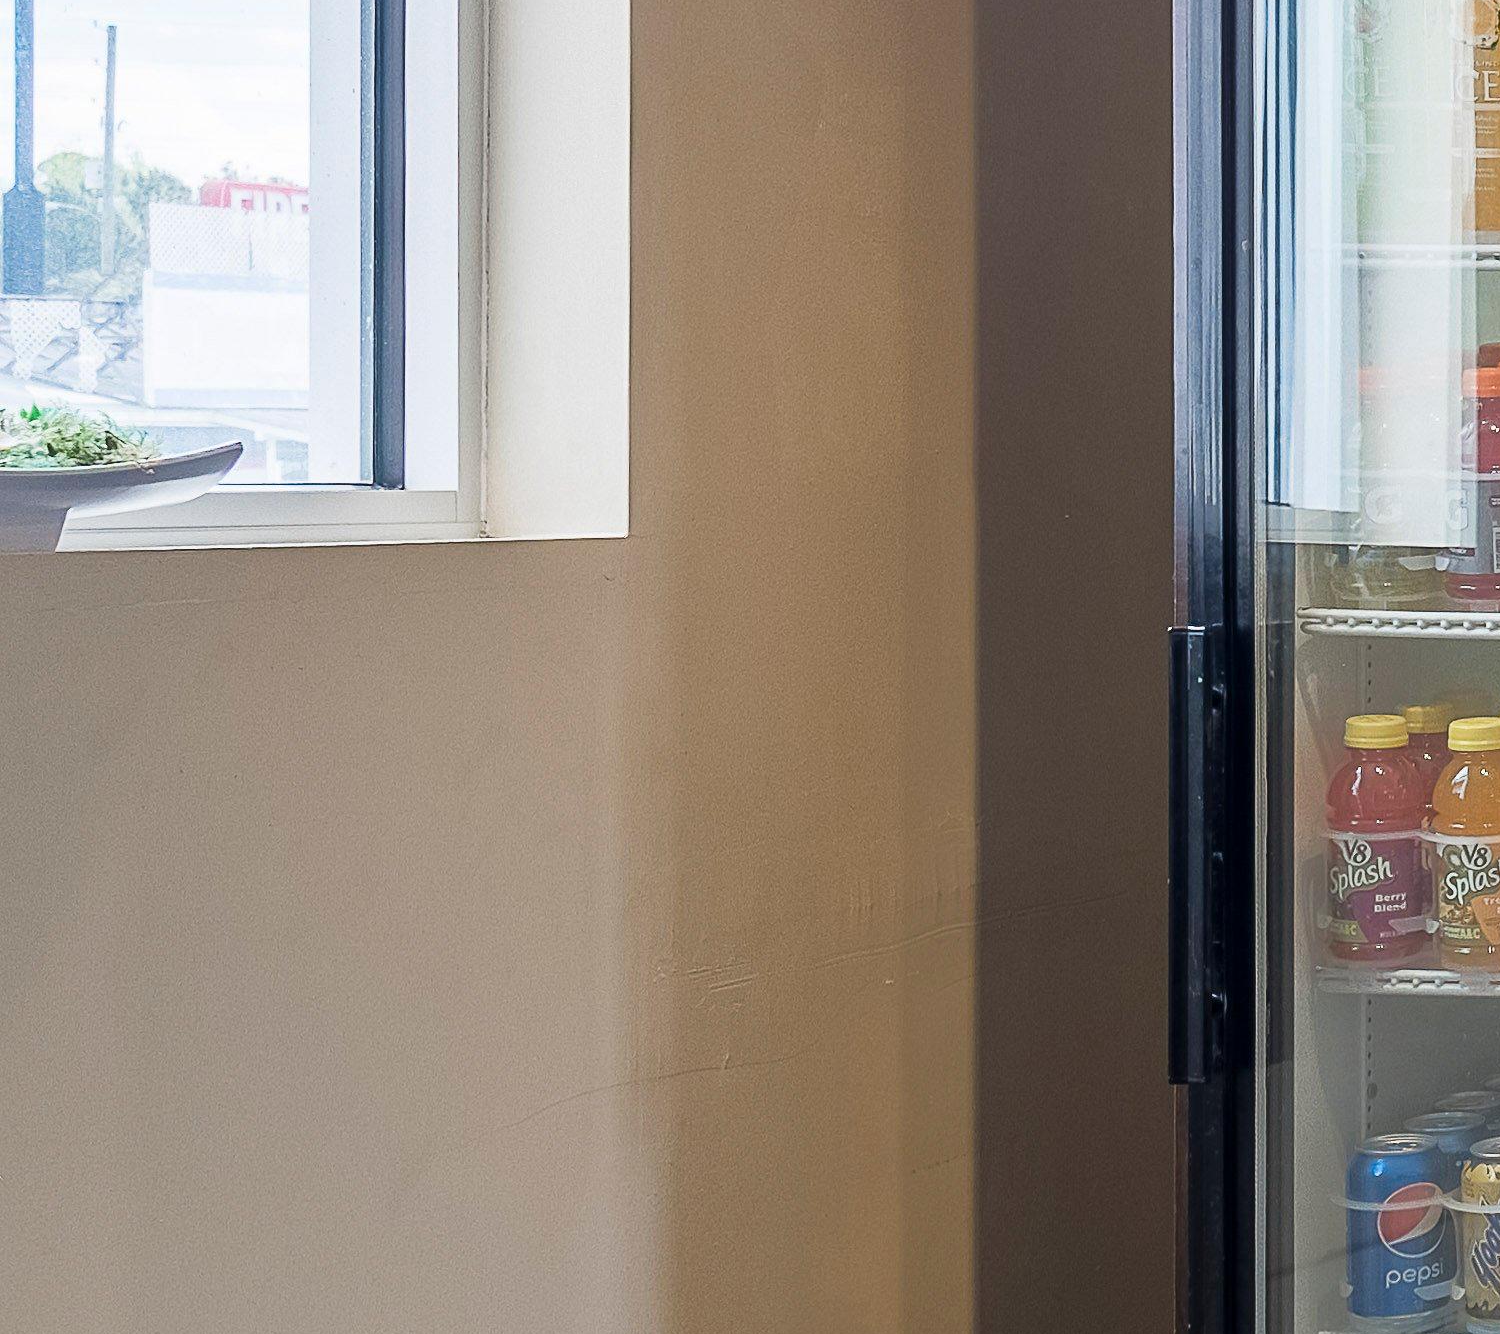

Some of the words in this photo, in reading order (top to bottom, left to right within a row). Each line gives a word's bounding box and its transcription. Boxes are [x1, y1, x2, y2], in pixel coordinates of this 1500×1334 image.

[1344, 840, 1368, 863] V8
[1463, 844, 1490, 867] V8
[1331, 858, 1393, 894] Splash
[1375, 893, 1406, 904] Berry
[1375, 902, 1406, 912] Blend
[1386, 1262, 1443, 1288] pepsi
